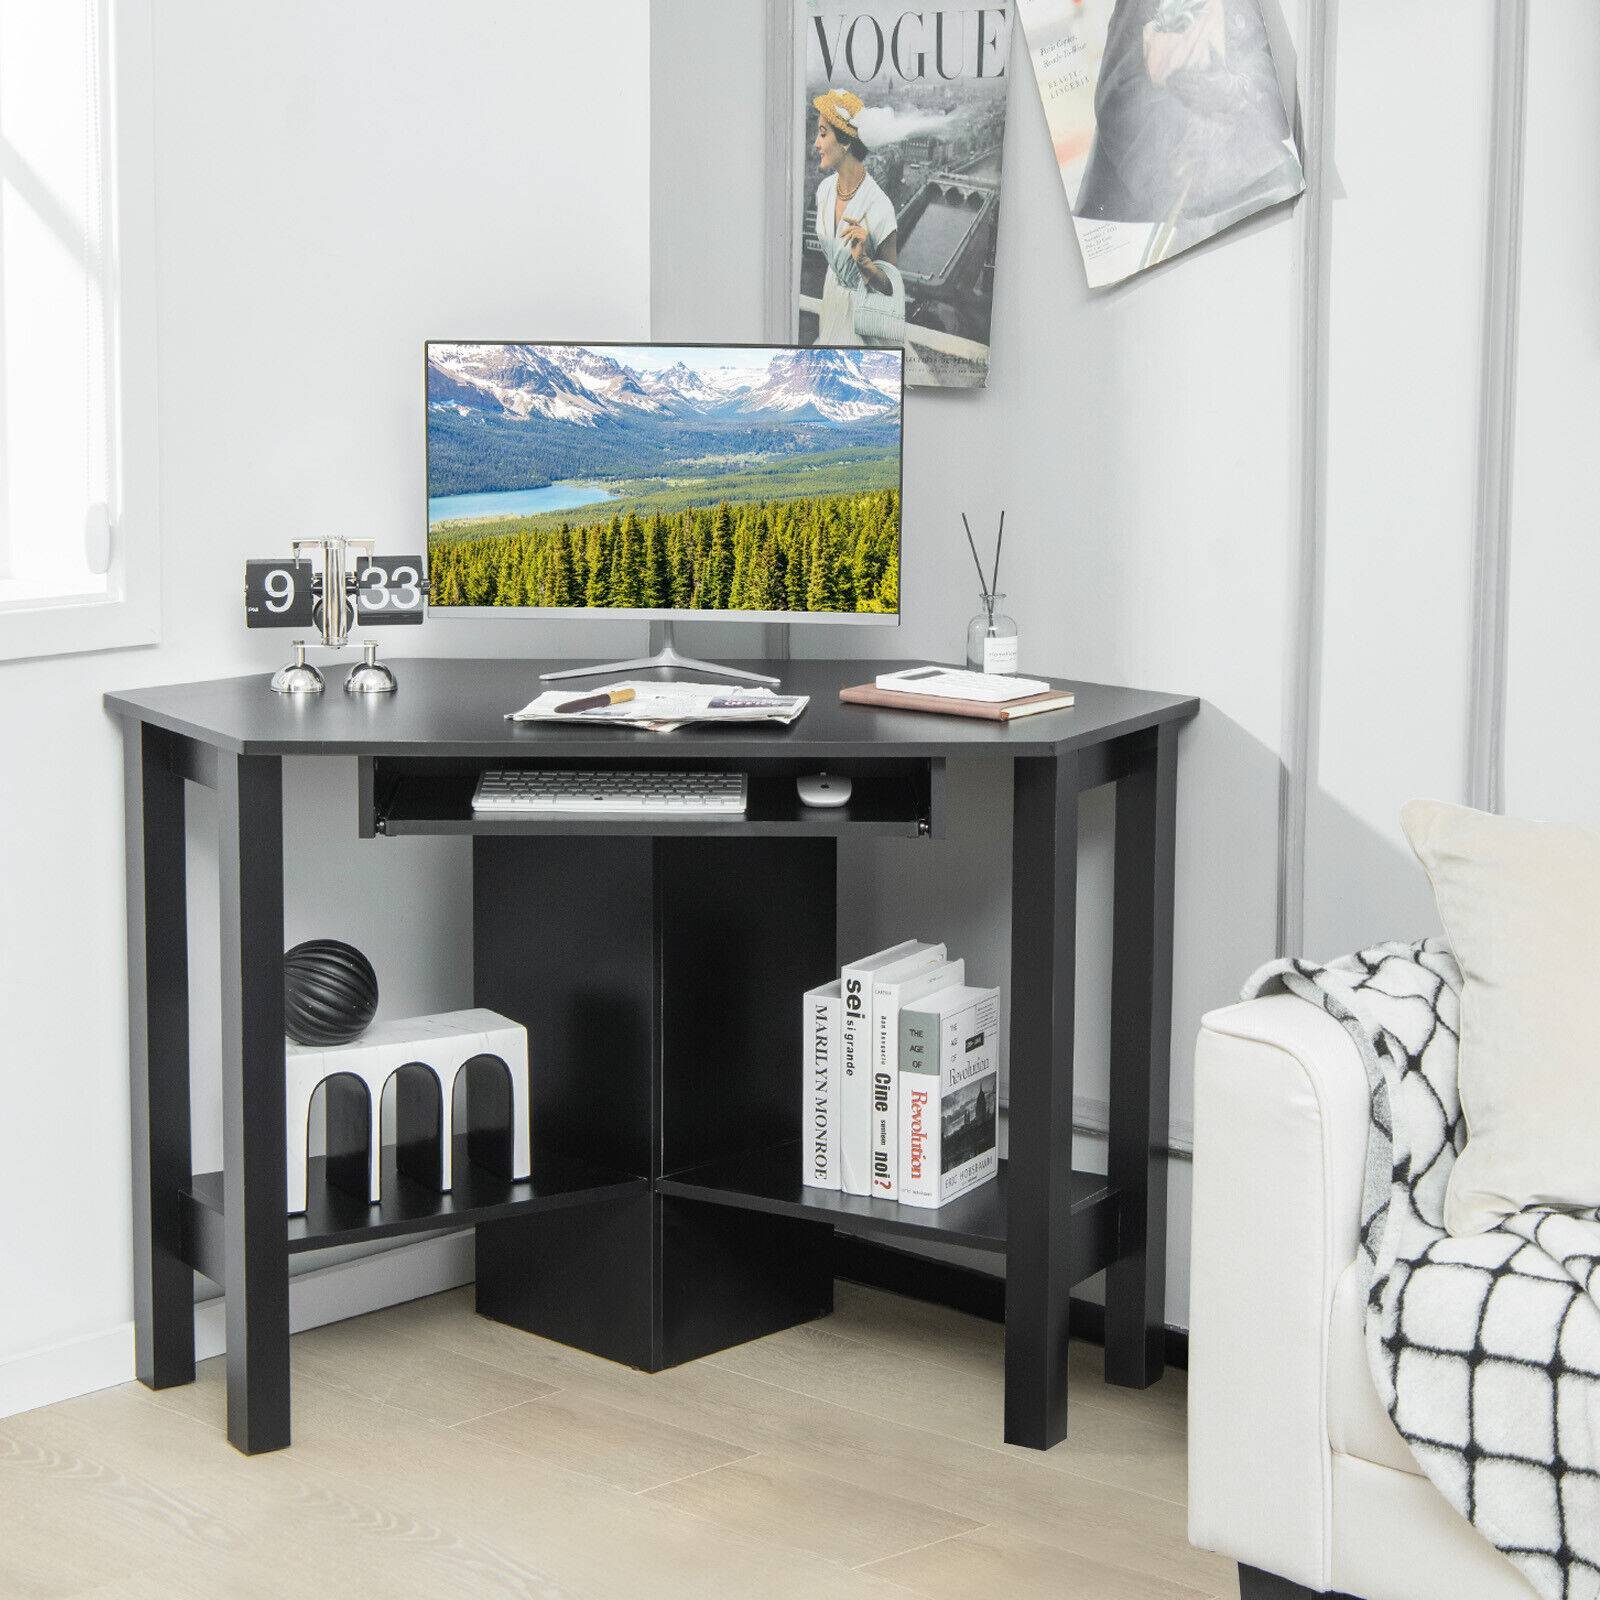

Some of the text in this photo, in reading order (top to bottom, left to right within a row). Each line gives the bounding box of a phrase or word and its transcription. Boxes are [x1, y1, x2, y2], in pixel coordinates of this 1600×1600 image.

[812, 8, 1006, 83] VOGUE
[264, 565, 421, 613] 9 33
[845, 979, 866, 1021] sei
[909, 1029, 924, 1038] THE
[909, 1045, 924, 1054] AGE
[844, 1032, 856, 1077] grande
[912, 1060, 923, 1069] OF
[949, 1057, 990, 1087] Revolution
[814, 1004, 829, 1180] MARILYN MONROE
[874, 1072, 892, 1112] Cine
[911, 1090, 928, 1179] Revolution
[874, 1150, 892, 1190] noi?
